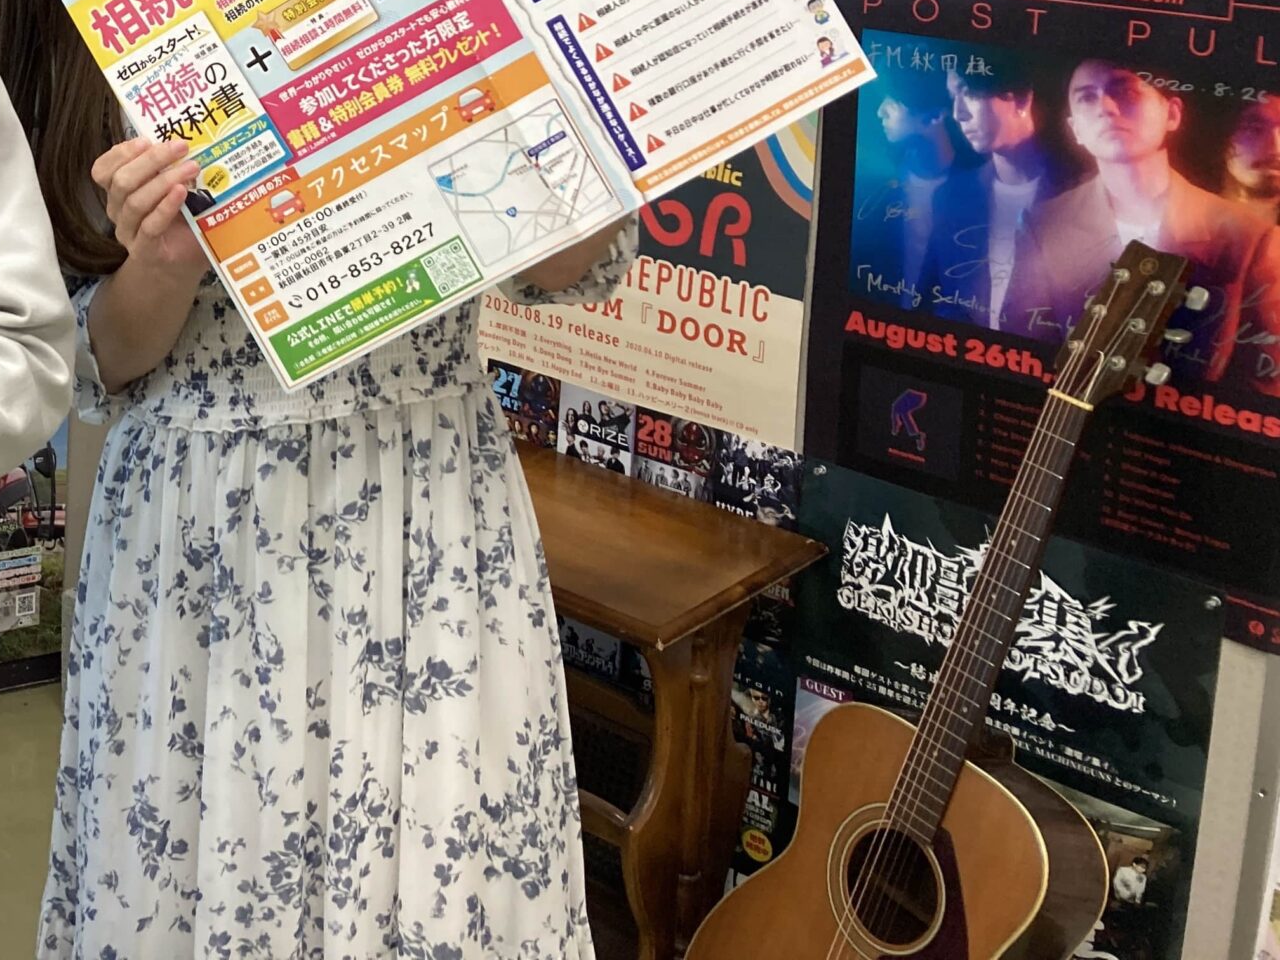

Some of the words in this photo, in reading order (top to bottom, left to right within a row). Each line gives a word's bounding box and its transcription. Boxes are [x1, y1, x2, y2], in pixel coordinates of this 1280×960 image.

[299, 11, 474, 117] 参加してくださった方限定
[134, 62, 228, 123] 相続の
[154, 82, 246, 143] 教科書
[306, 110, 450, 200] アクセスマップ
[306, 221, 437, 302] 018-853-8227
[483, 294, 564, 331] 2020.08.19
[568, 320, 621, 348] release
[844, 310, 957, 357] August
[626, 340, 663, 359] 2020.06.10
[664, 349, 685, 365] Digital
[686, 355, 713, 373] release
[589, 421, 629, 447] RIZE
[638, 413, 673, 444] 28
[638, 441, 672, 462] SUN
[805, 678, 846, 700] GUEST
[1035, 747, 1112, 783] MACHINEGUNS
